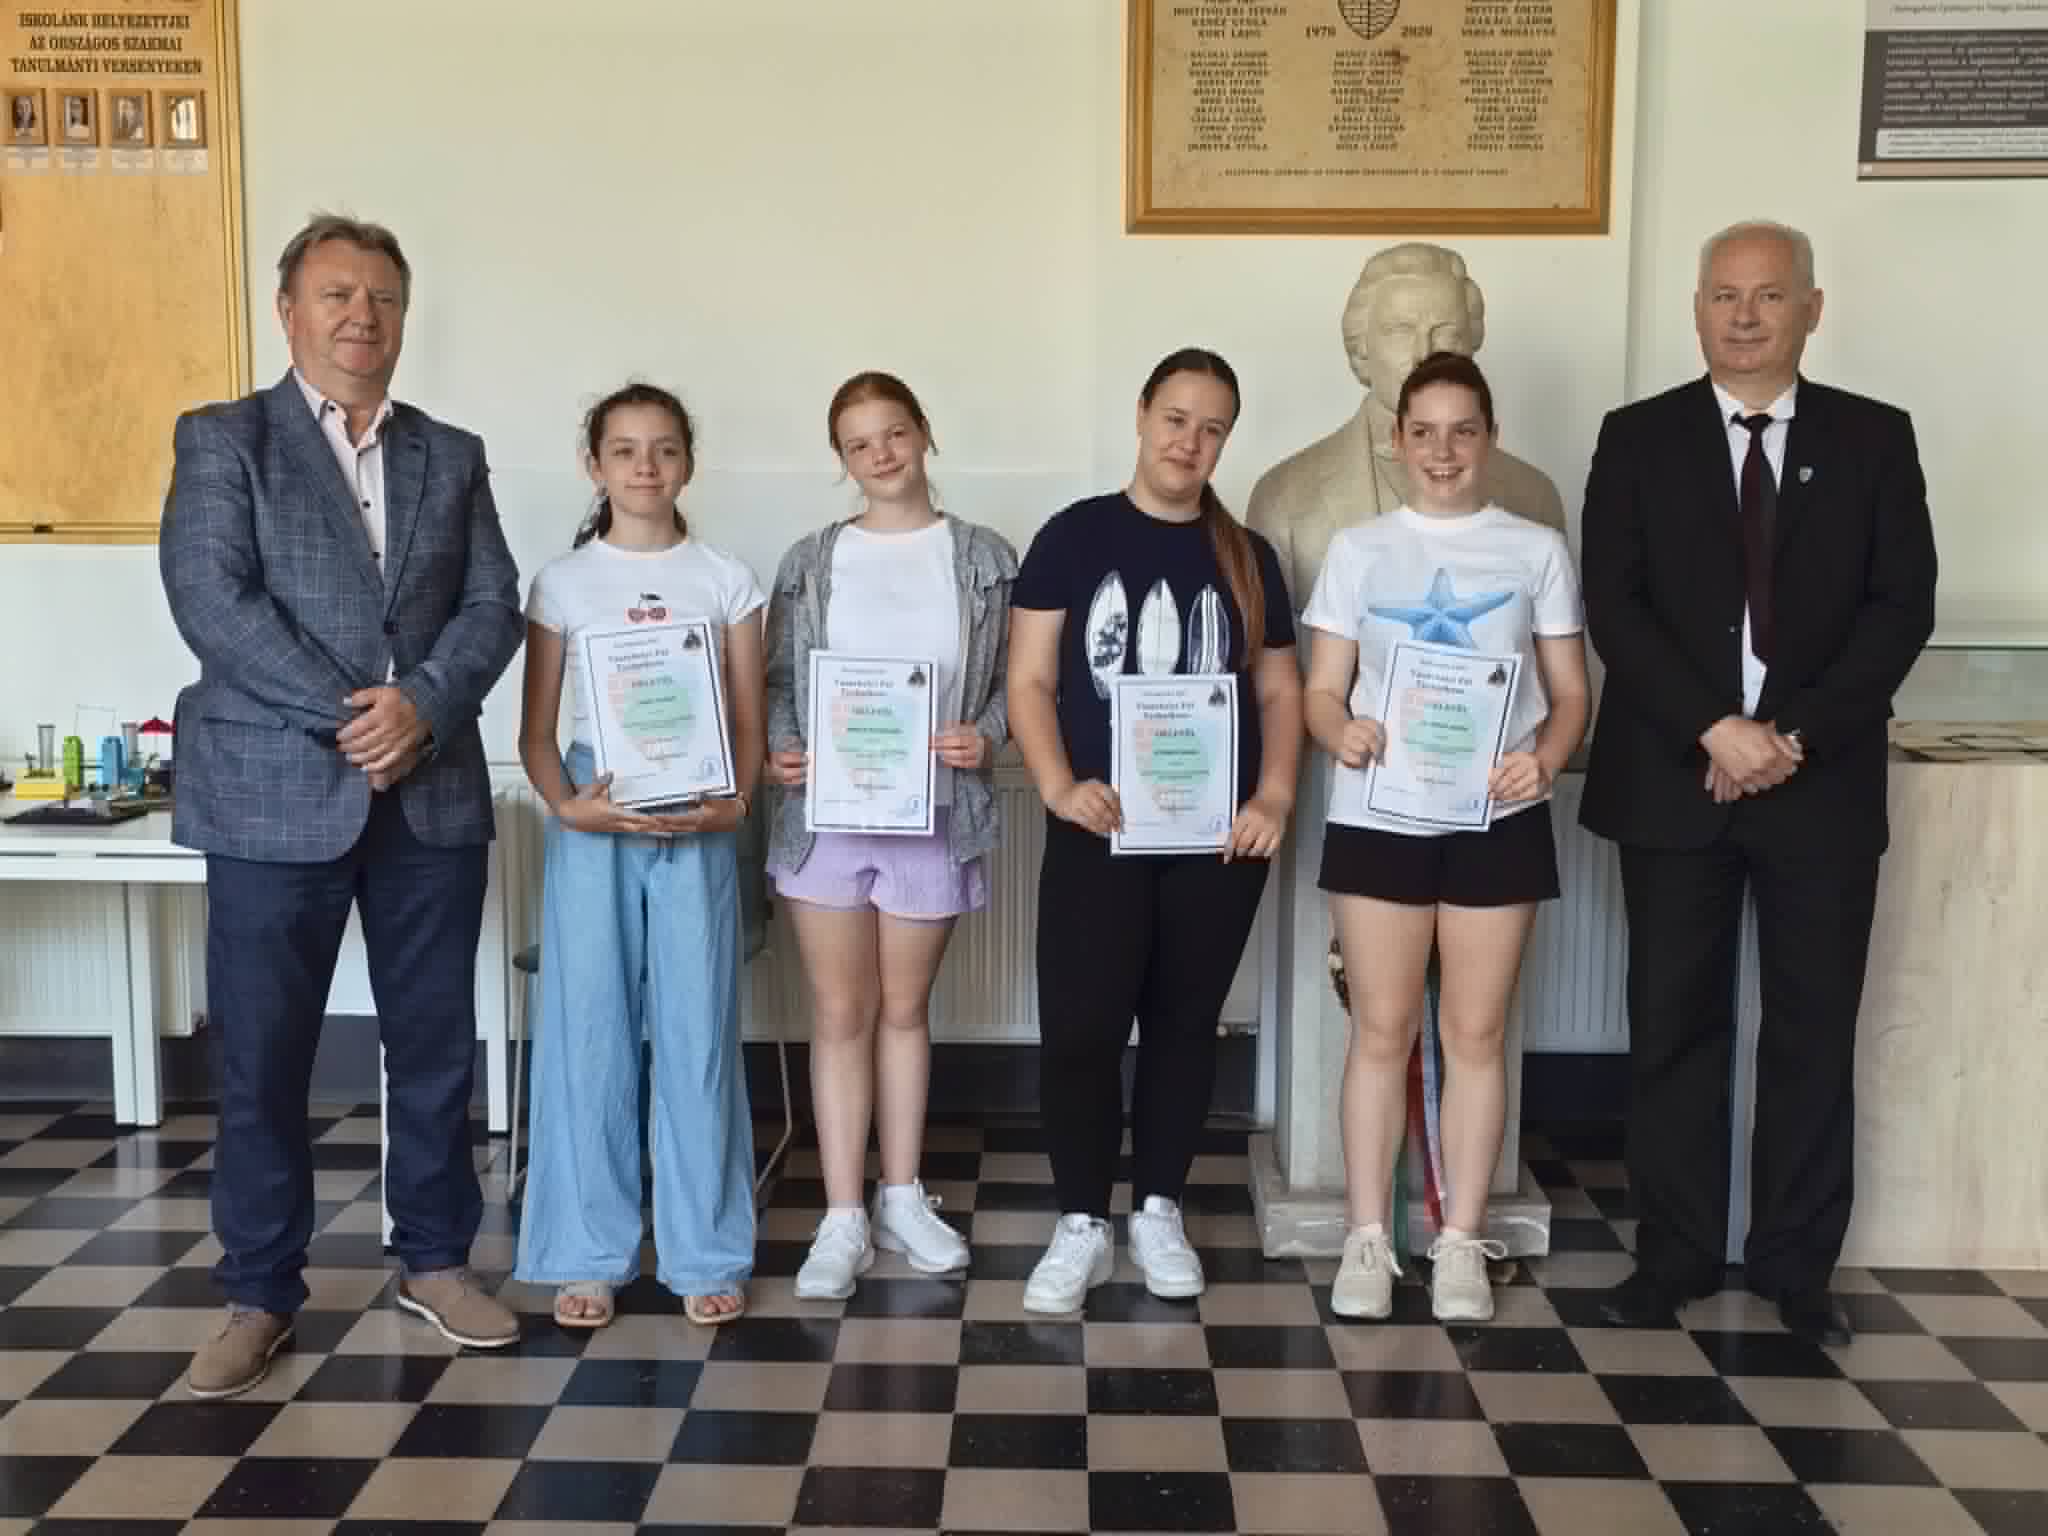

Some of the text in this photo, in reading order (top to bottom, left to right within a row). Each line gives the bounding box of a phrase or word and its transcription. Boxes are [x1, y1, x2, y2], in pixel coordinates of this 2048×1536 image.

[91, 14, 191, 30] HELYEZETTJEI
[29, 36, 46, 50] AZ
[49, 33, 121, 51] ORSZÁGOS
[8, 55, 202, 74] TANULMÁNYI VERSENYEKEN
